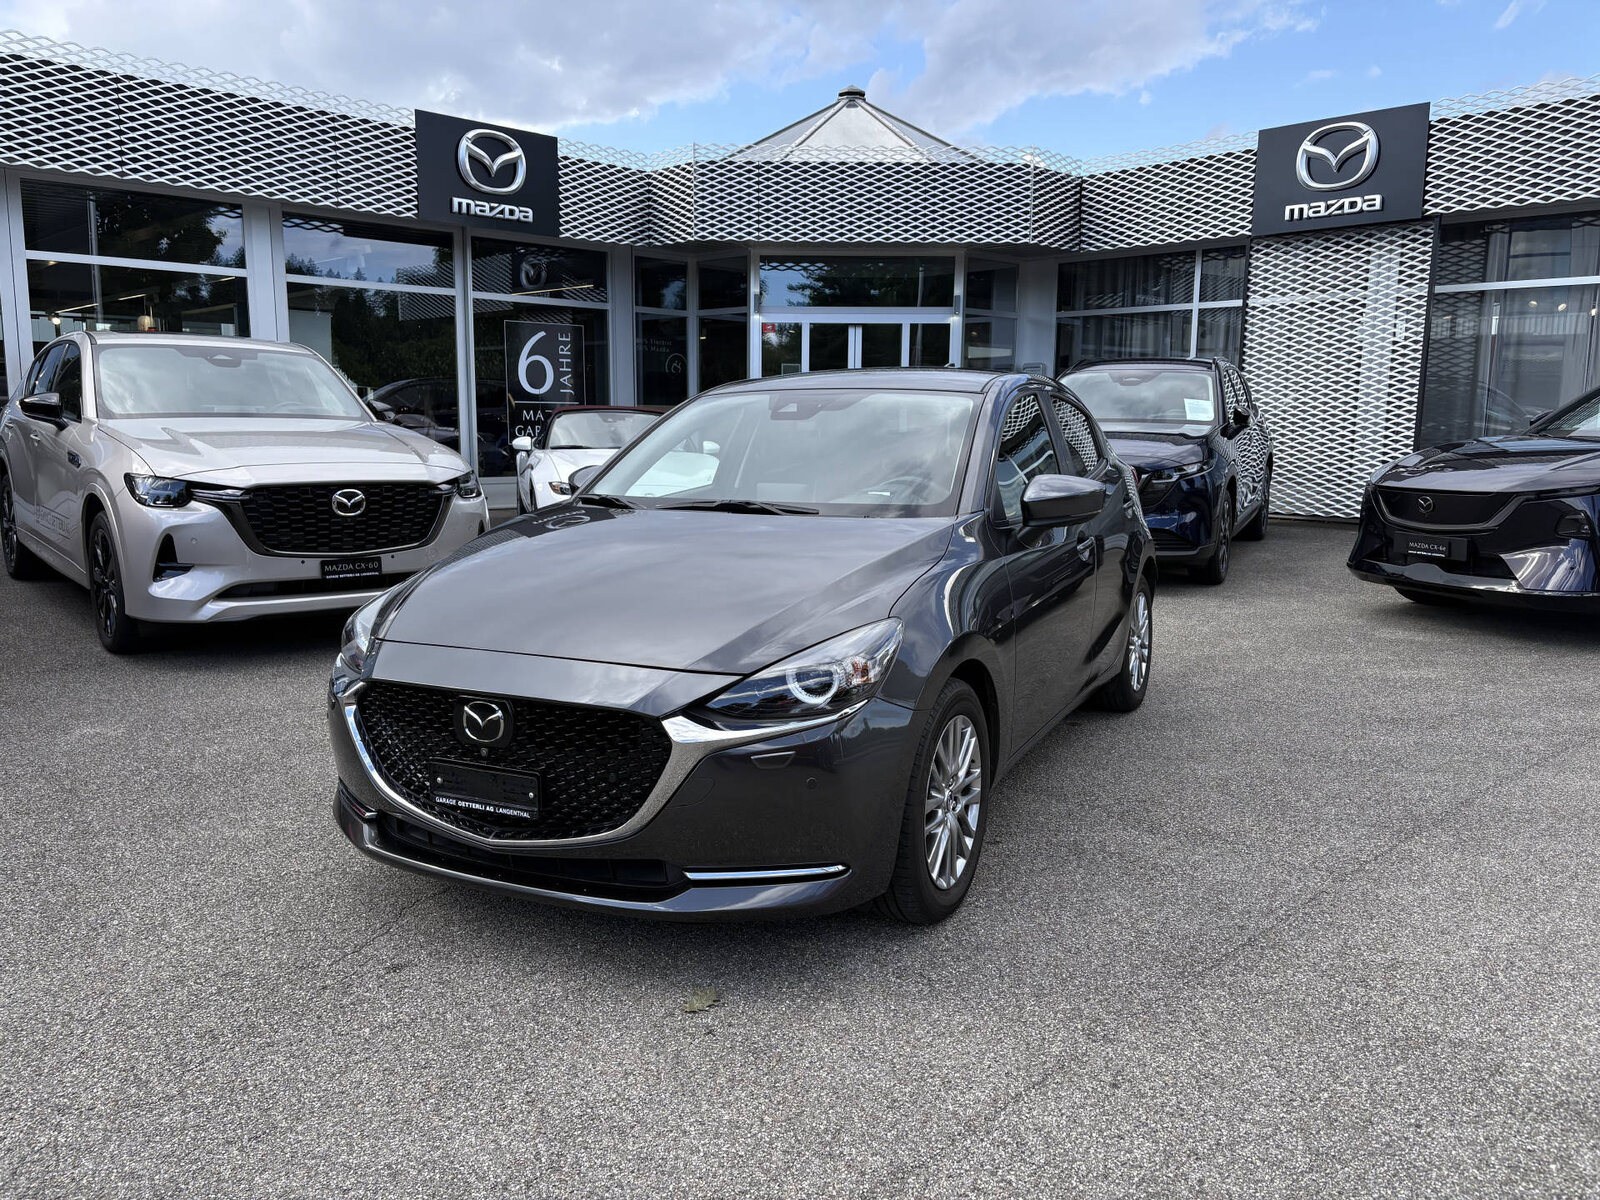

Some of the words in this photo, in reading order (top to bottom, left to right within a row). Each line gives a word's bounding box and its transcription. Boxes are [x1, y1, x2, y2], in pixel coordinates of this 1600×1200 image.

[518, 330, 555, 395] 6
[558, 332, 575, 395] JAHRE
[522, 409, 552, 421] MA
[324, 563, 354, 572] MAZDA
[355, 561, 379, 570] CX-60
[435, 796, 457, 806] GARAGE
[457, 800, 485, 811] OETTERLI
[486, 804, 494, 812] AG
[495, 807, 531, 819] LANGENTHAL
